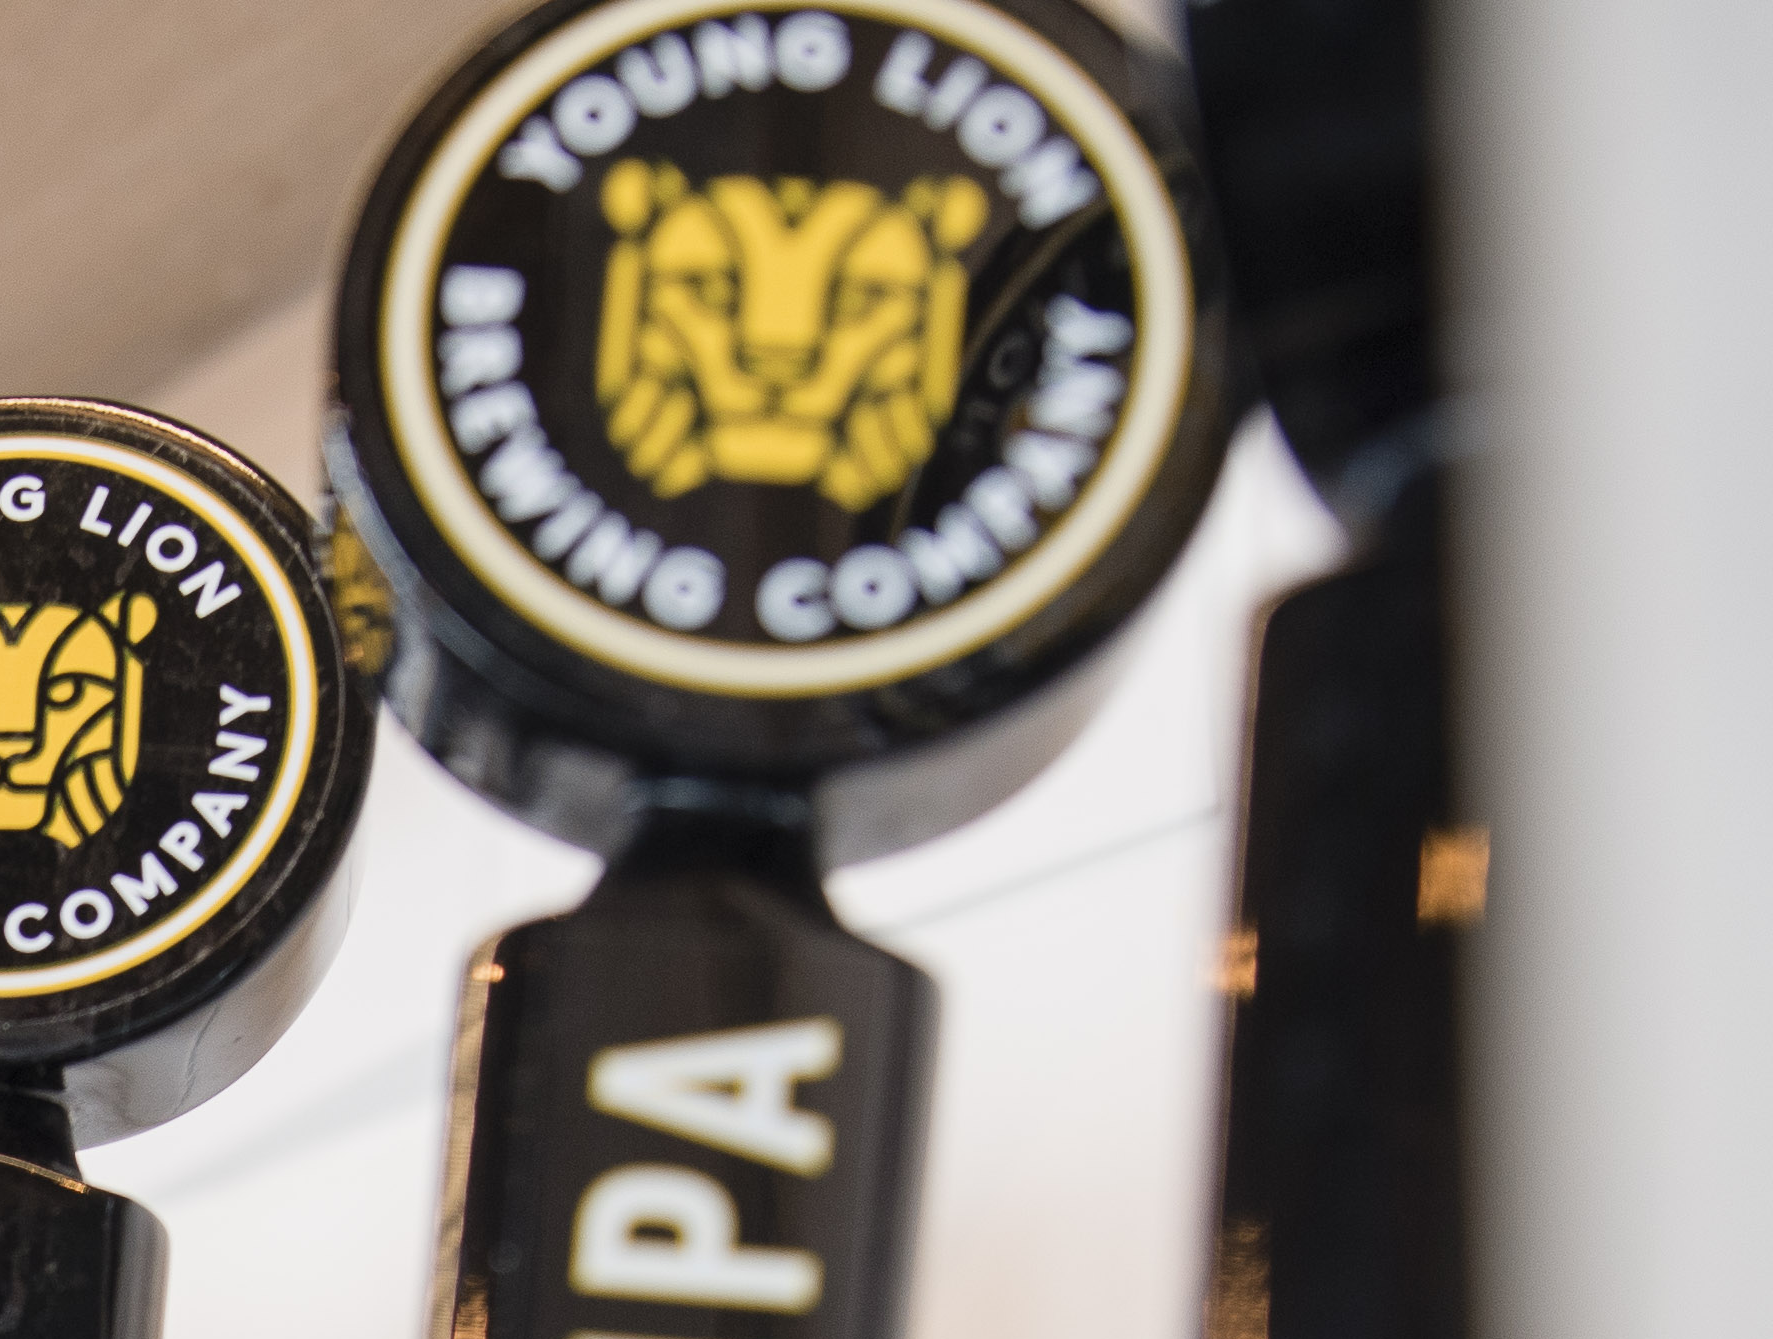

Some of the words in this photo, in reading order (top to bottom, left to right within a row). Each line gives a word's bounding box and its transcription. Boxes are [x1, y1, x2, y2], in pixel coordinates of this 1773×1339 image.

[498, 10, 850, 192] YOUNG
[873, 29, 1100, 229] LION
[79, 485, 242, 620] LION
[440, 265, 726, 632] BREWING
[756, 295, 1133, 643] COMPANY
[3, 683, 272, 954] COMPANY
